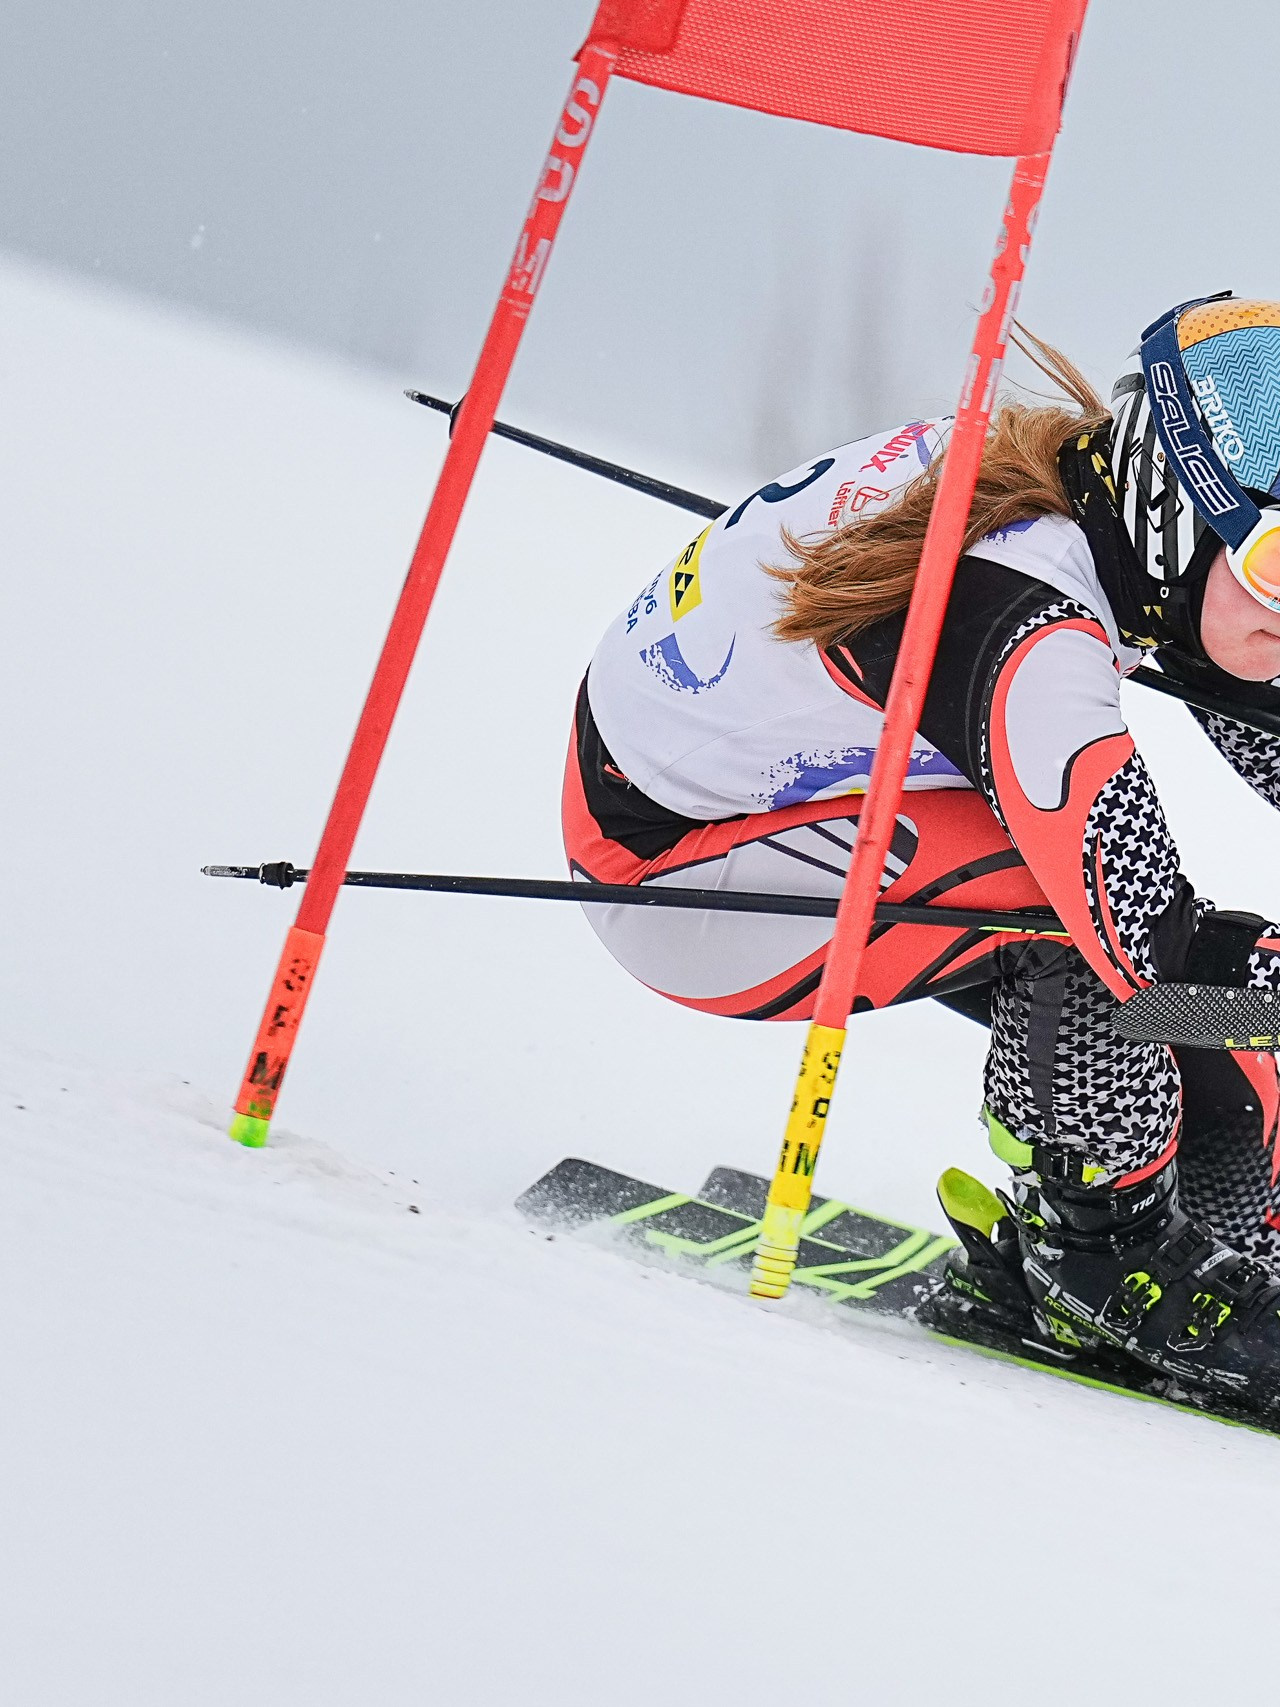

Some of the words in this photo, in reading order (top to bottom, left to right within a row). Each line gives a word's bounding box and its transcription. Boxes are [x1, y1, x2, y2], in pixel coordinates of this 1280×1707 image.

[1150, 361, 1241, 517] SALICE
[1192, 374, 1246, 463] BRIKO
[1131, 1193, 1156, 1215] 110
